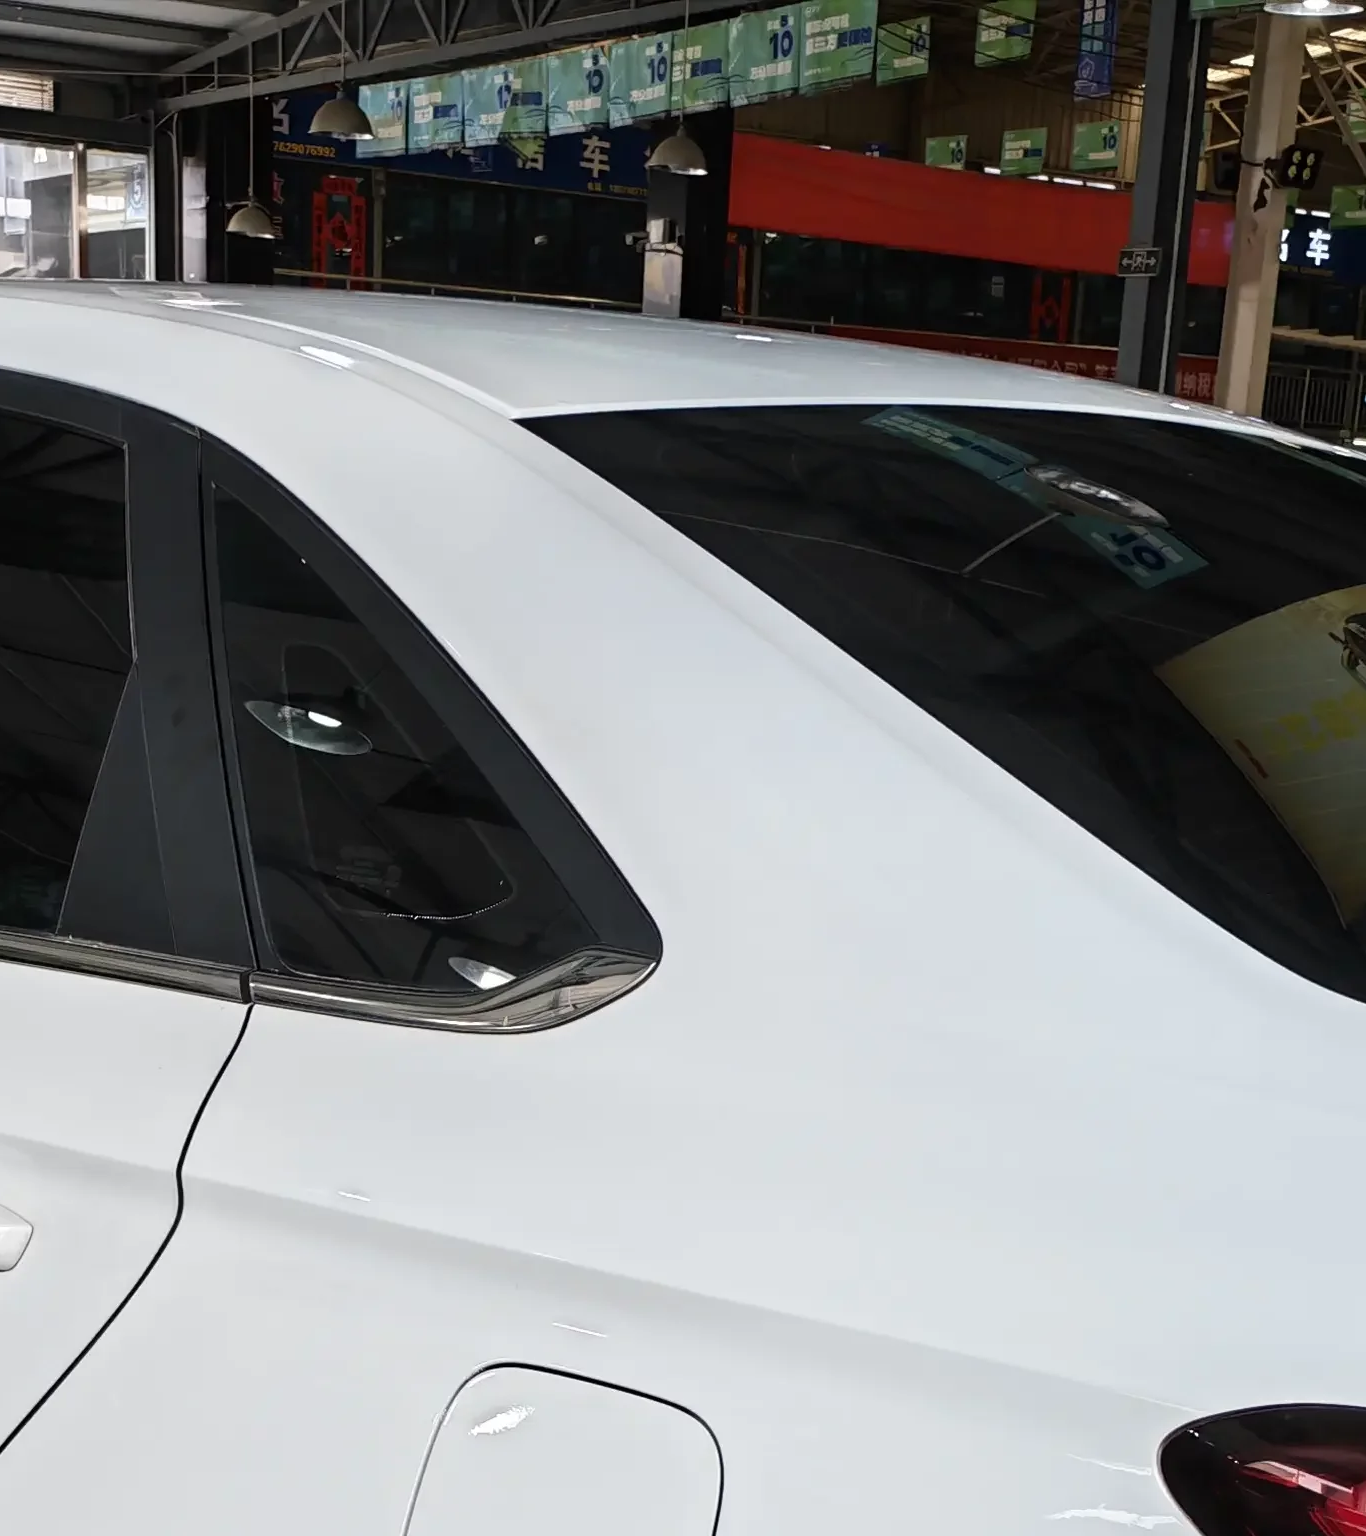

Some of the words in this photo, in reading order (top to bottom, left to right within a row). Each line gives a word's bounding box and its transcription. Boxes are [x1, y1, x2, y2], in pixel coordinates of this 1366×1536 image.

[769, 30, 794, 59] 10
[585, 68, 604, 95] 10
[647, 56, 667, 84] 10
[1101, 133, 1117, 151] 10
